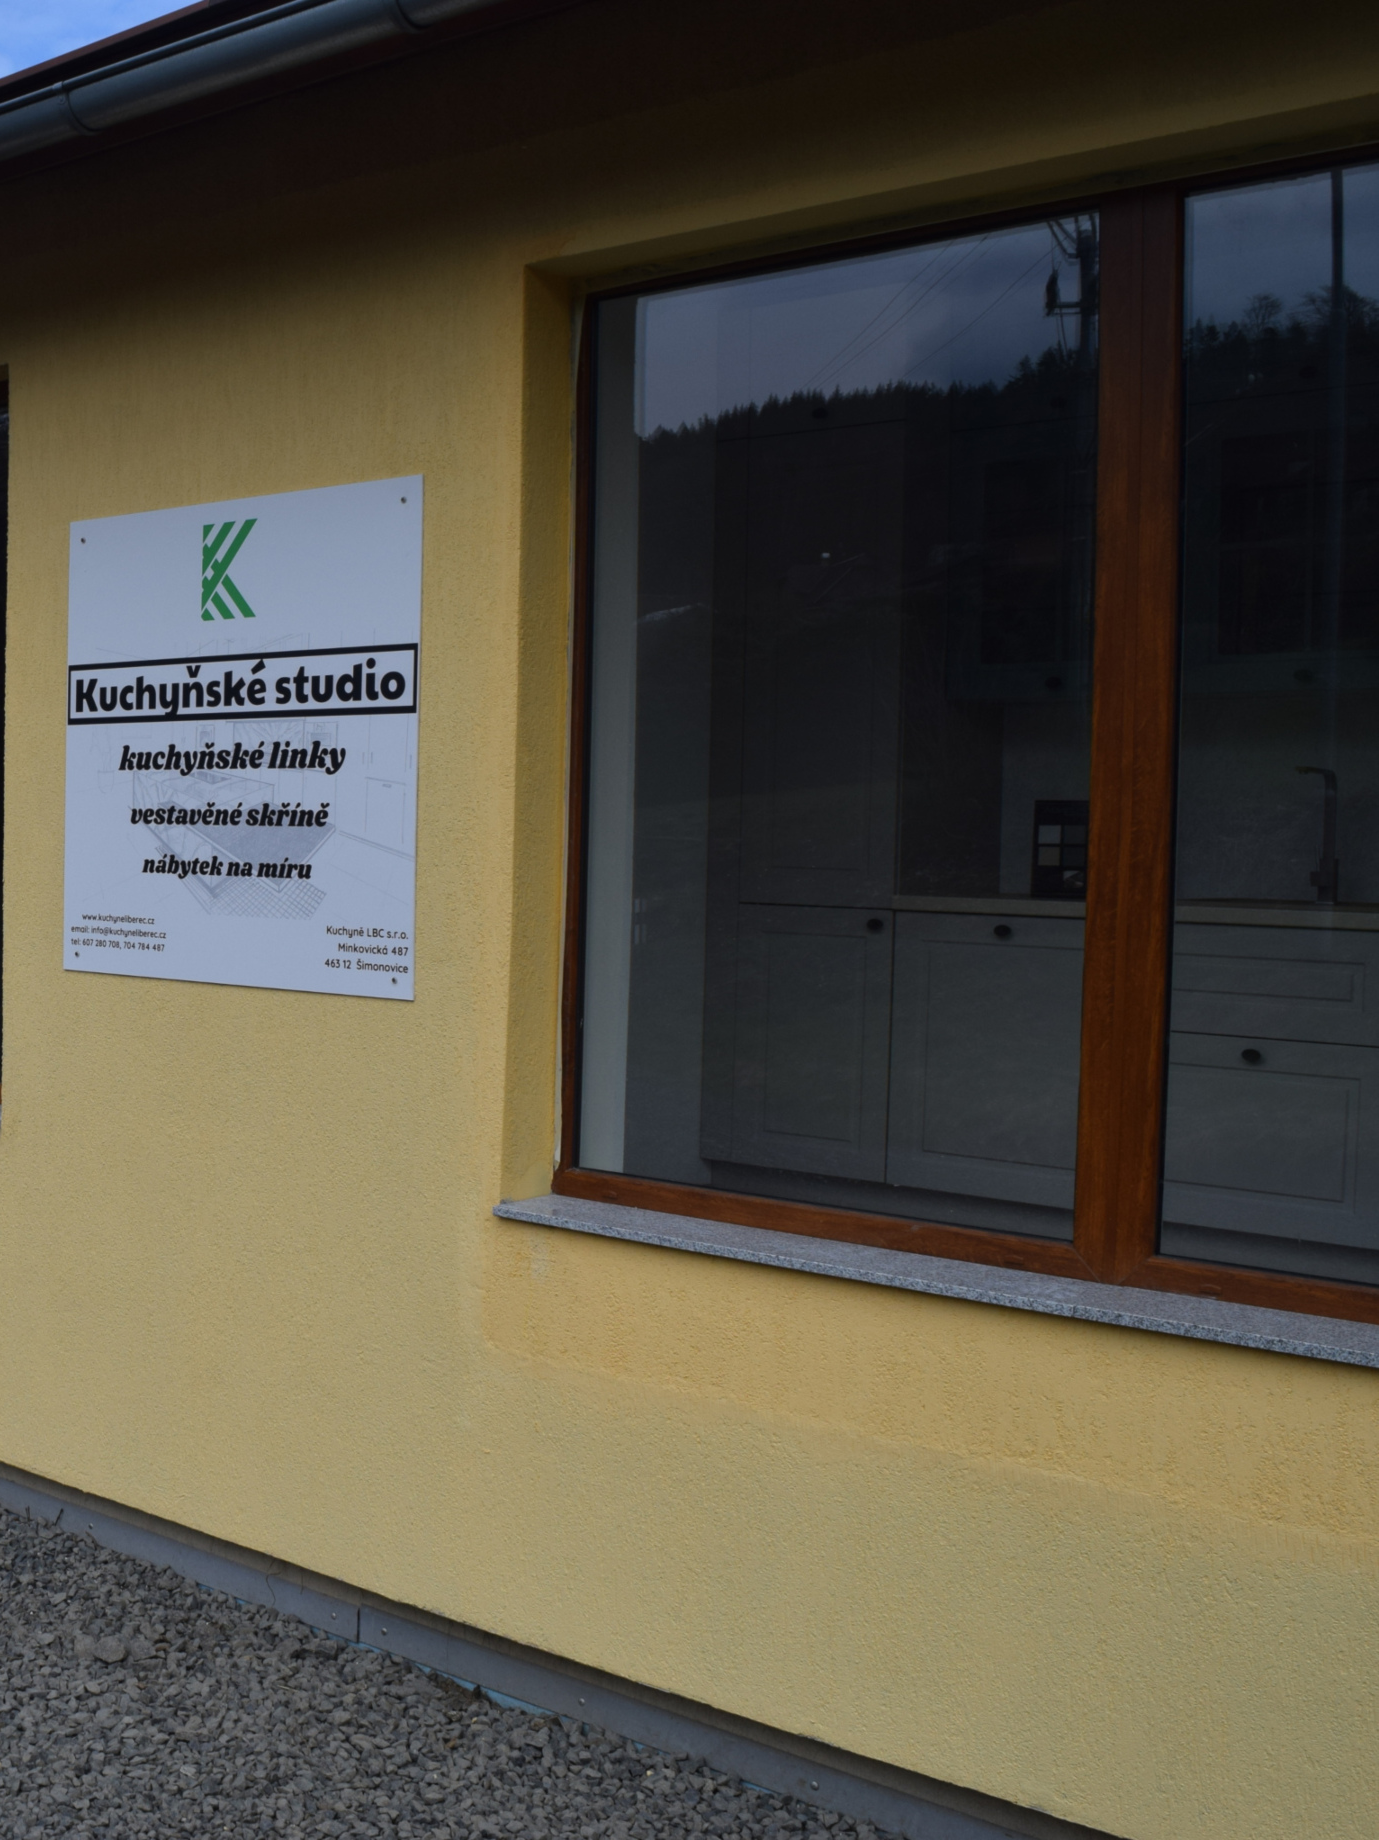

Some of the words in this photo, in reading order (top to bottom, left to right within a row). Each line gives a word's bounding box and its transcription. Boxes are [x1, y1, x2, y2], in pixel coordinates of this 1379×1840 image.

[75, 658, 266, 717] Kuchyňské
[275, 657, 406, 706] studio
[119, 741, 265, 776] kuchyňské
[267, 741, 346, 775] linky
[130, 802, 242, 826] vestavěné
[245, 802, 330, 827] skříně
[142, 854, 223, 879] nábytek
[226, 859, 253, 876] na
[256, 857, 312, 879] míru
[82, 914, 155, 924] www.kuchyneliberec.cz
[70, 926, 89, 934] email:
[90, 926, 167, 939] info@kuchyneliberec.cz
[326, 925, 364, 938] Kuchyně
[366, 928, 385, 938] LBC
[386, 930, 409, 940] s.r.o.
[82, 938, 94, 947] 607
[95, 939, 107, 948] 280
[108, 940, 122, 950] 708,
[123, 941, 136, 950] 704
[137, 942, 150, 951] 784
[152, 943, 165, 952] 487
[338, 943, 388, 955] Minkovická
[391, 947, 409, 956] 487
[324, 959, 340, 968] 463
[342, 960, 352, 969] 12
[356, 959, 409, 973] Šimonovice
